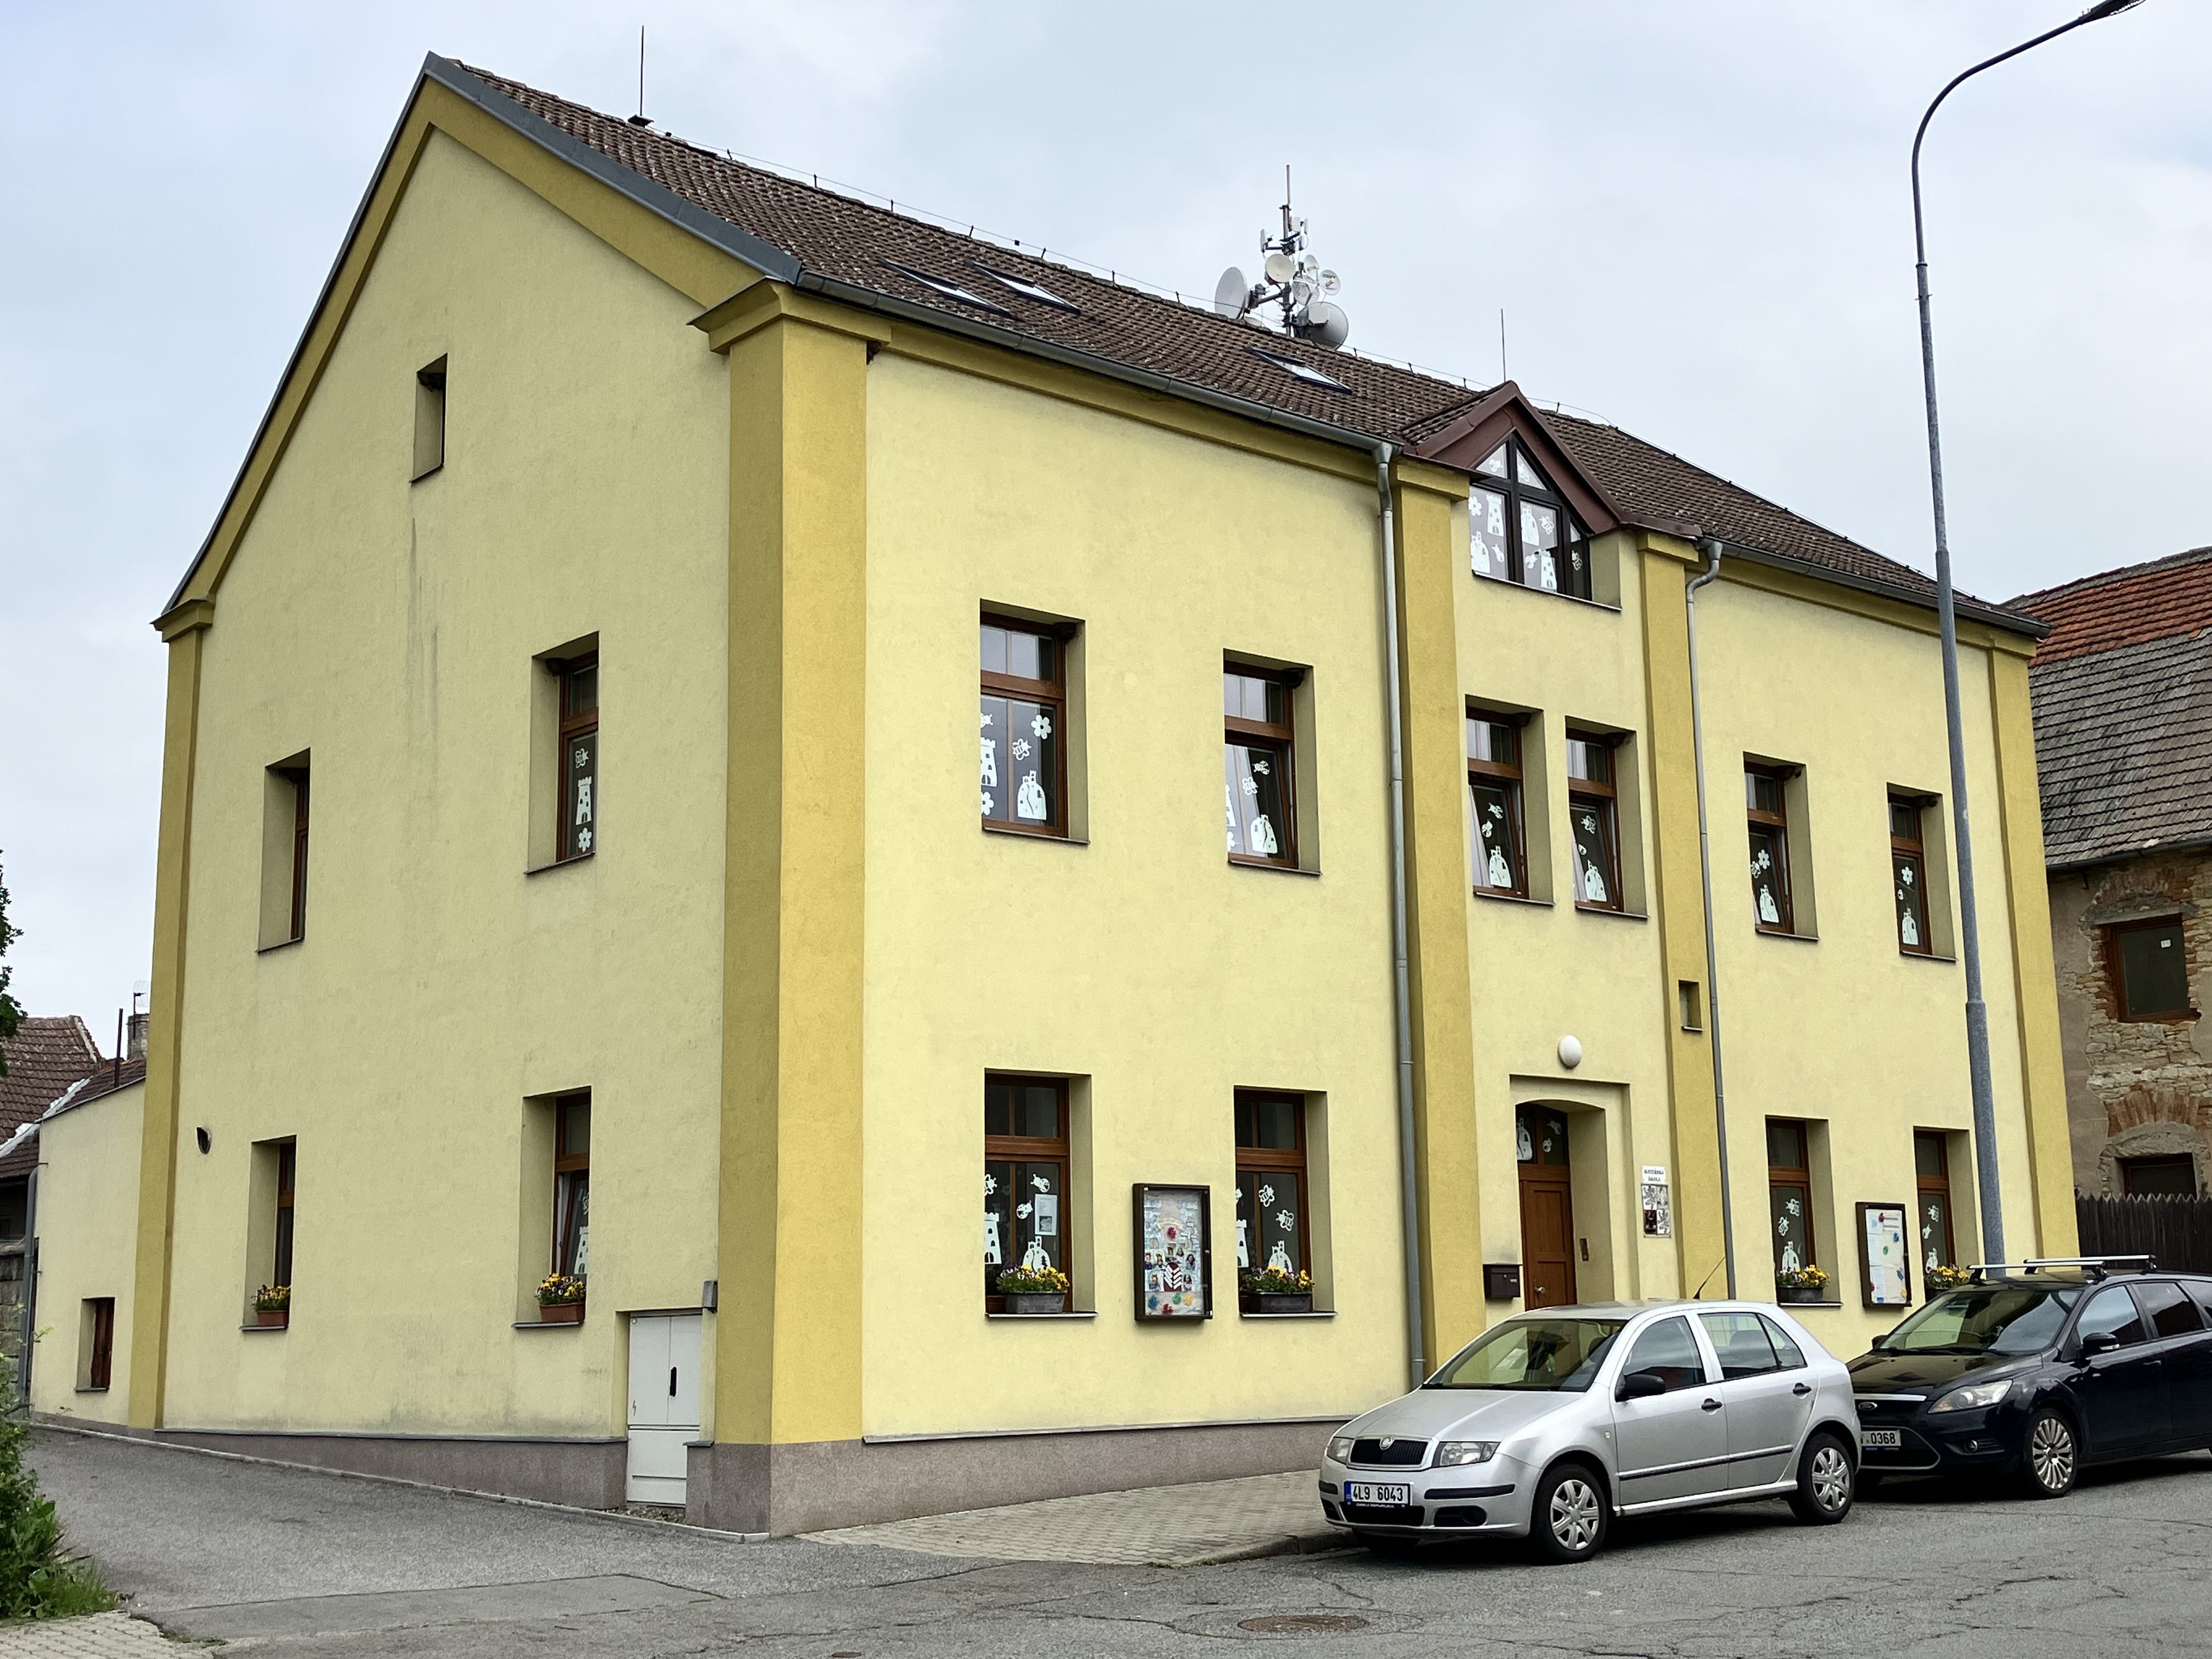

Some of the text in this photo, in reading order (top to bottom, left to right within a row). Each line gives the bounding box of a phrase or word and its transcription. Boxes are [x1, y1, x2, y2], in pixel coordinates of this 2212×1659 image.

[1871, 1432, 1895, 1444] 0368
[1353, 1485, 1403, 1502] 4L9 6043
